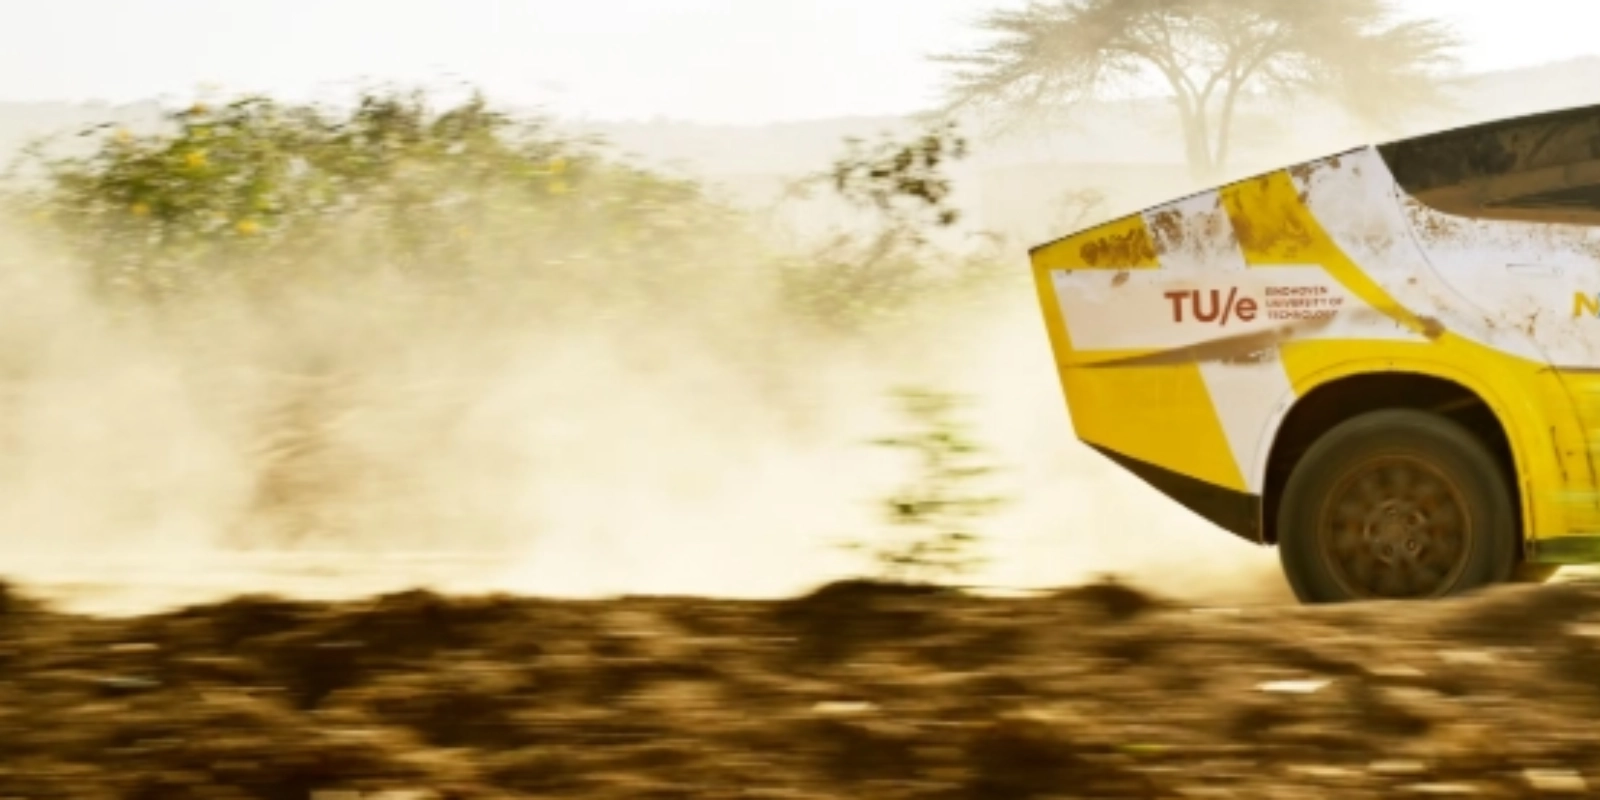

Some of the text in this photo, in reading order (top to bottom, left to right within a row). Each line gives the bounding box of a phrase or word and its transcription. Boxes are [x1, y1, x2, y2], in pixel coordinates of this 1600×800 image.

[1265, 286, 1328, 297] EINDHOVEN
[1164, 287, 1258, 327] TU/e
[1265, 297, 1327, 308] UNIVERSITY
